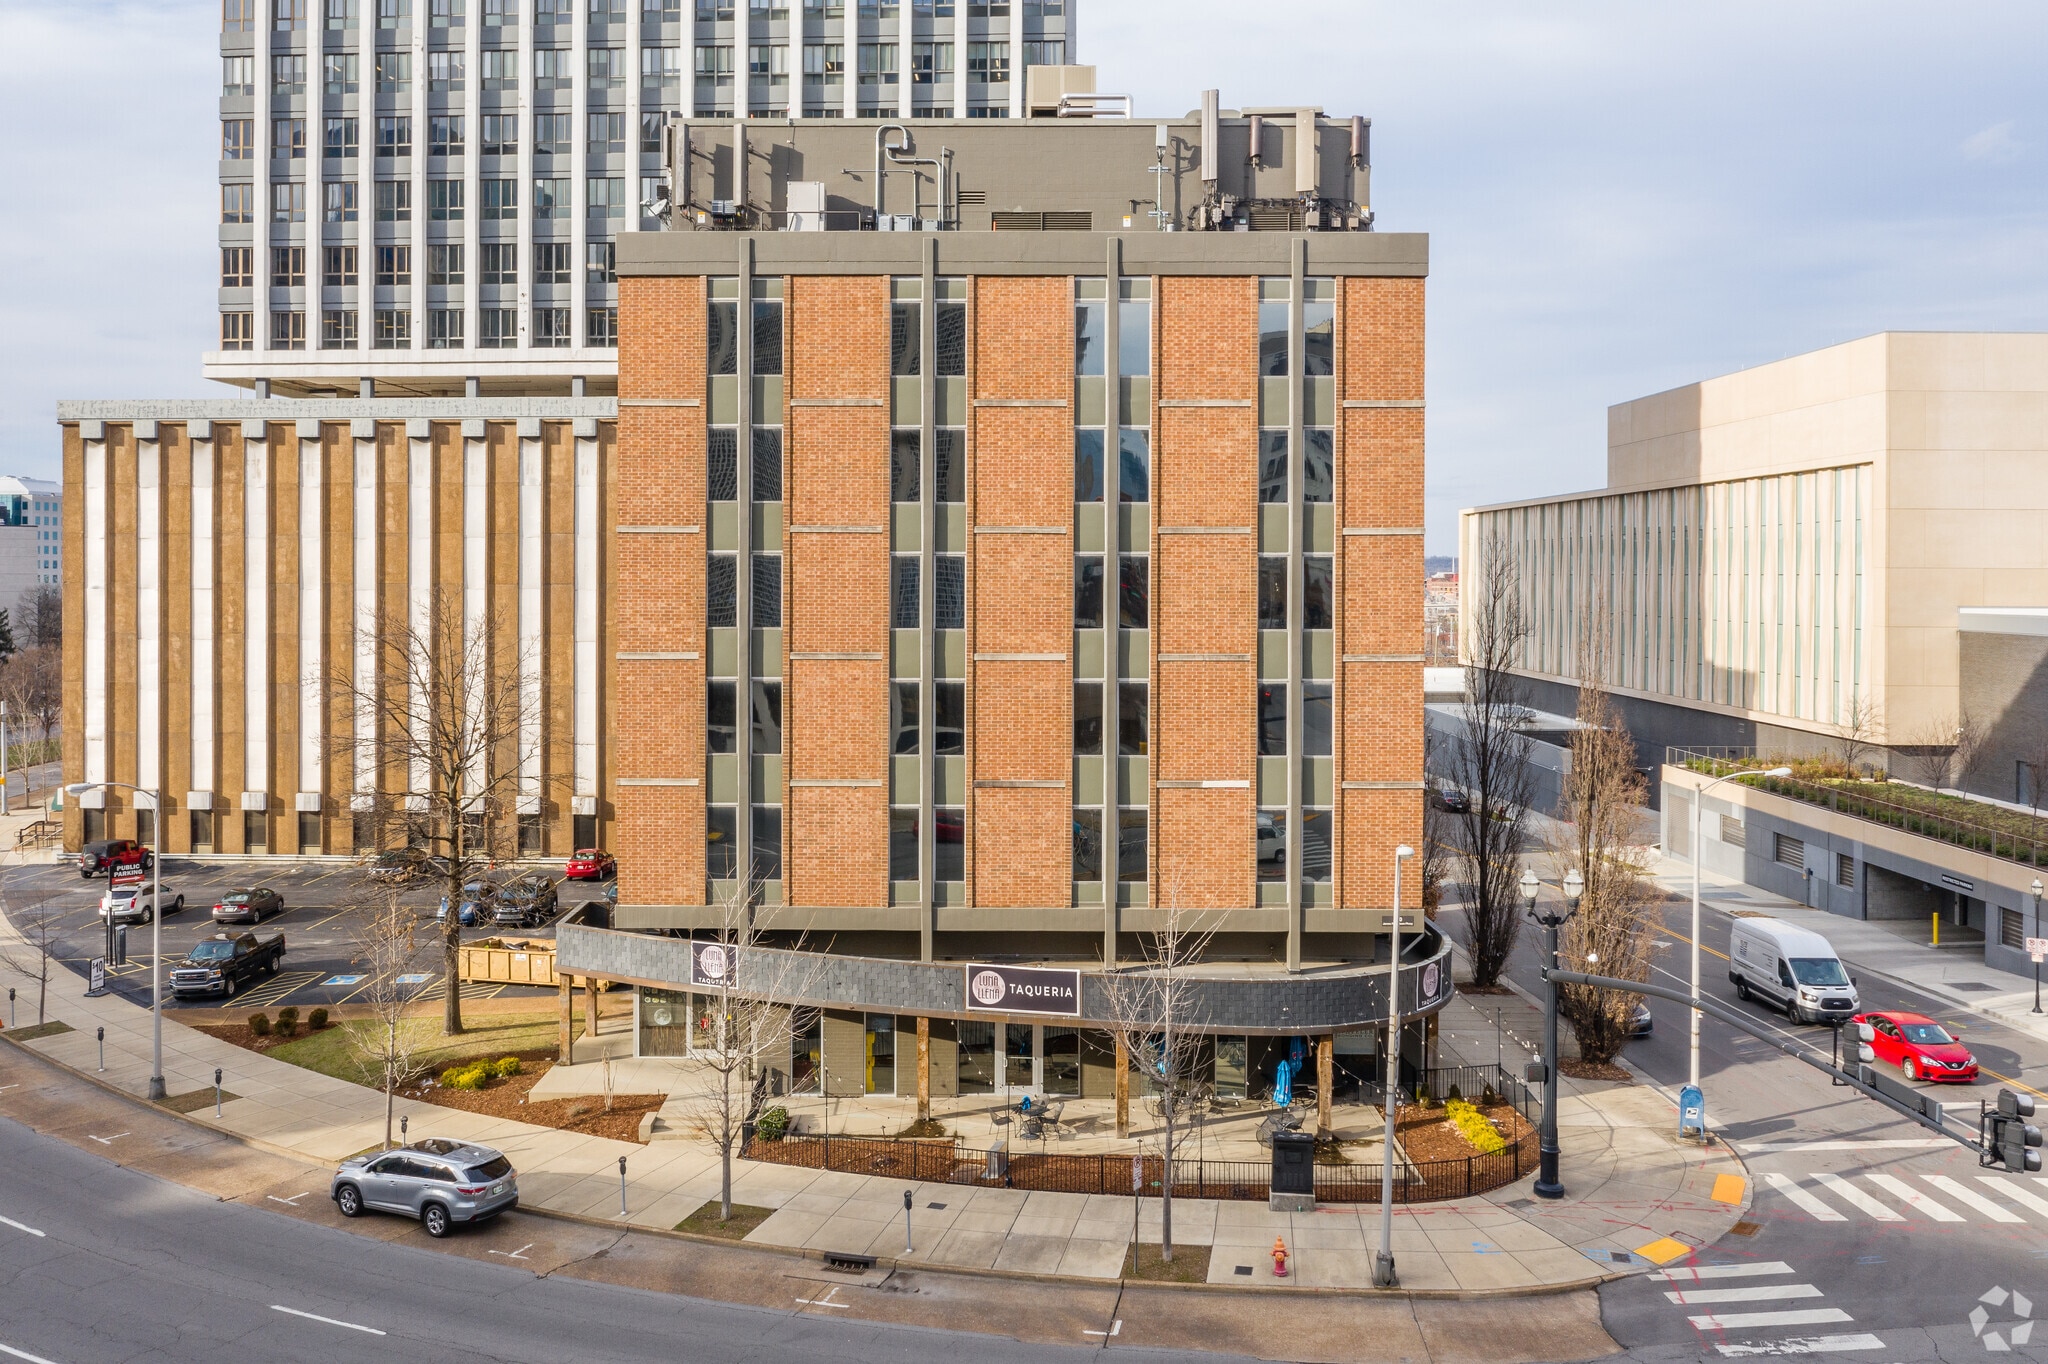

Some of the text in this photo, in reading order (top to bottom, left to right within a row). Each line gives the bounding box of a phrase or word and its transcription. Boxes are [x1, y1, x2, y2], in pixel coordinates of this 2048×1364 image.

[116, 863, 140, 871] PUBLIC
[113, 869, 143, 877] PARKING
[92, 960, 103, 973] $10
[698, 977, 730, 986] TAQUERA
[979, 975, 999, 987] LUNA
[977, 988, 1000, 1000] LLENA
[1009, 983, 1073, 998] TAQUERIA
[1421, 995, 1439, 1006] TAQUERIA
